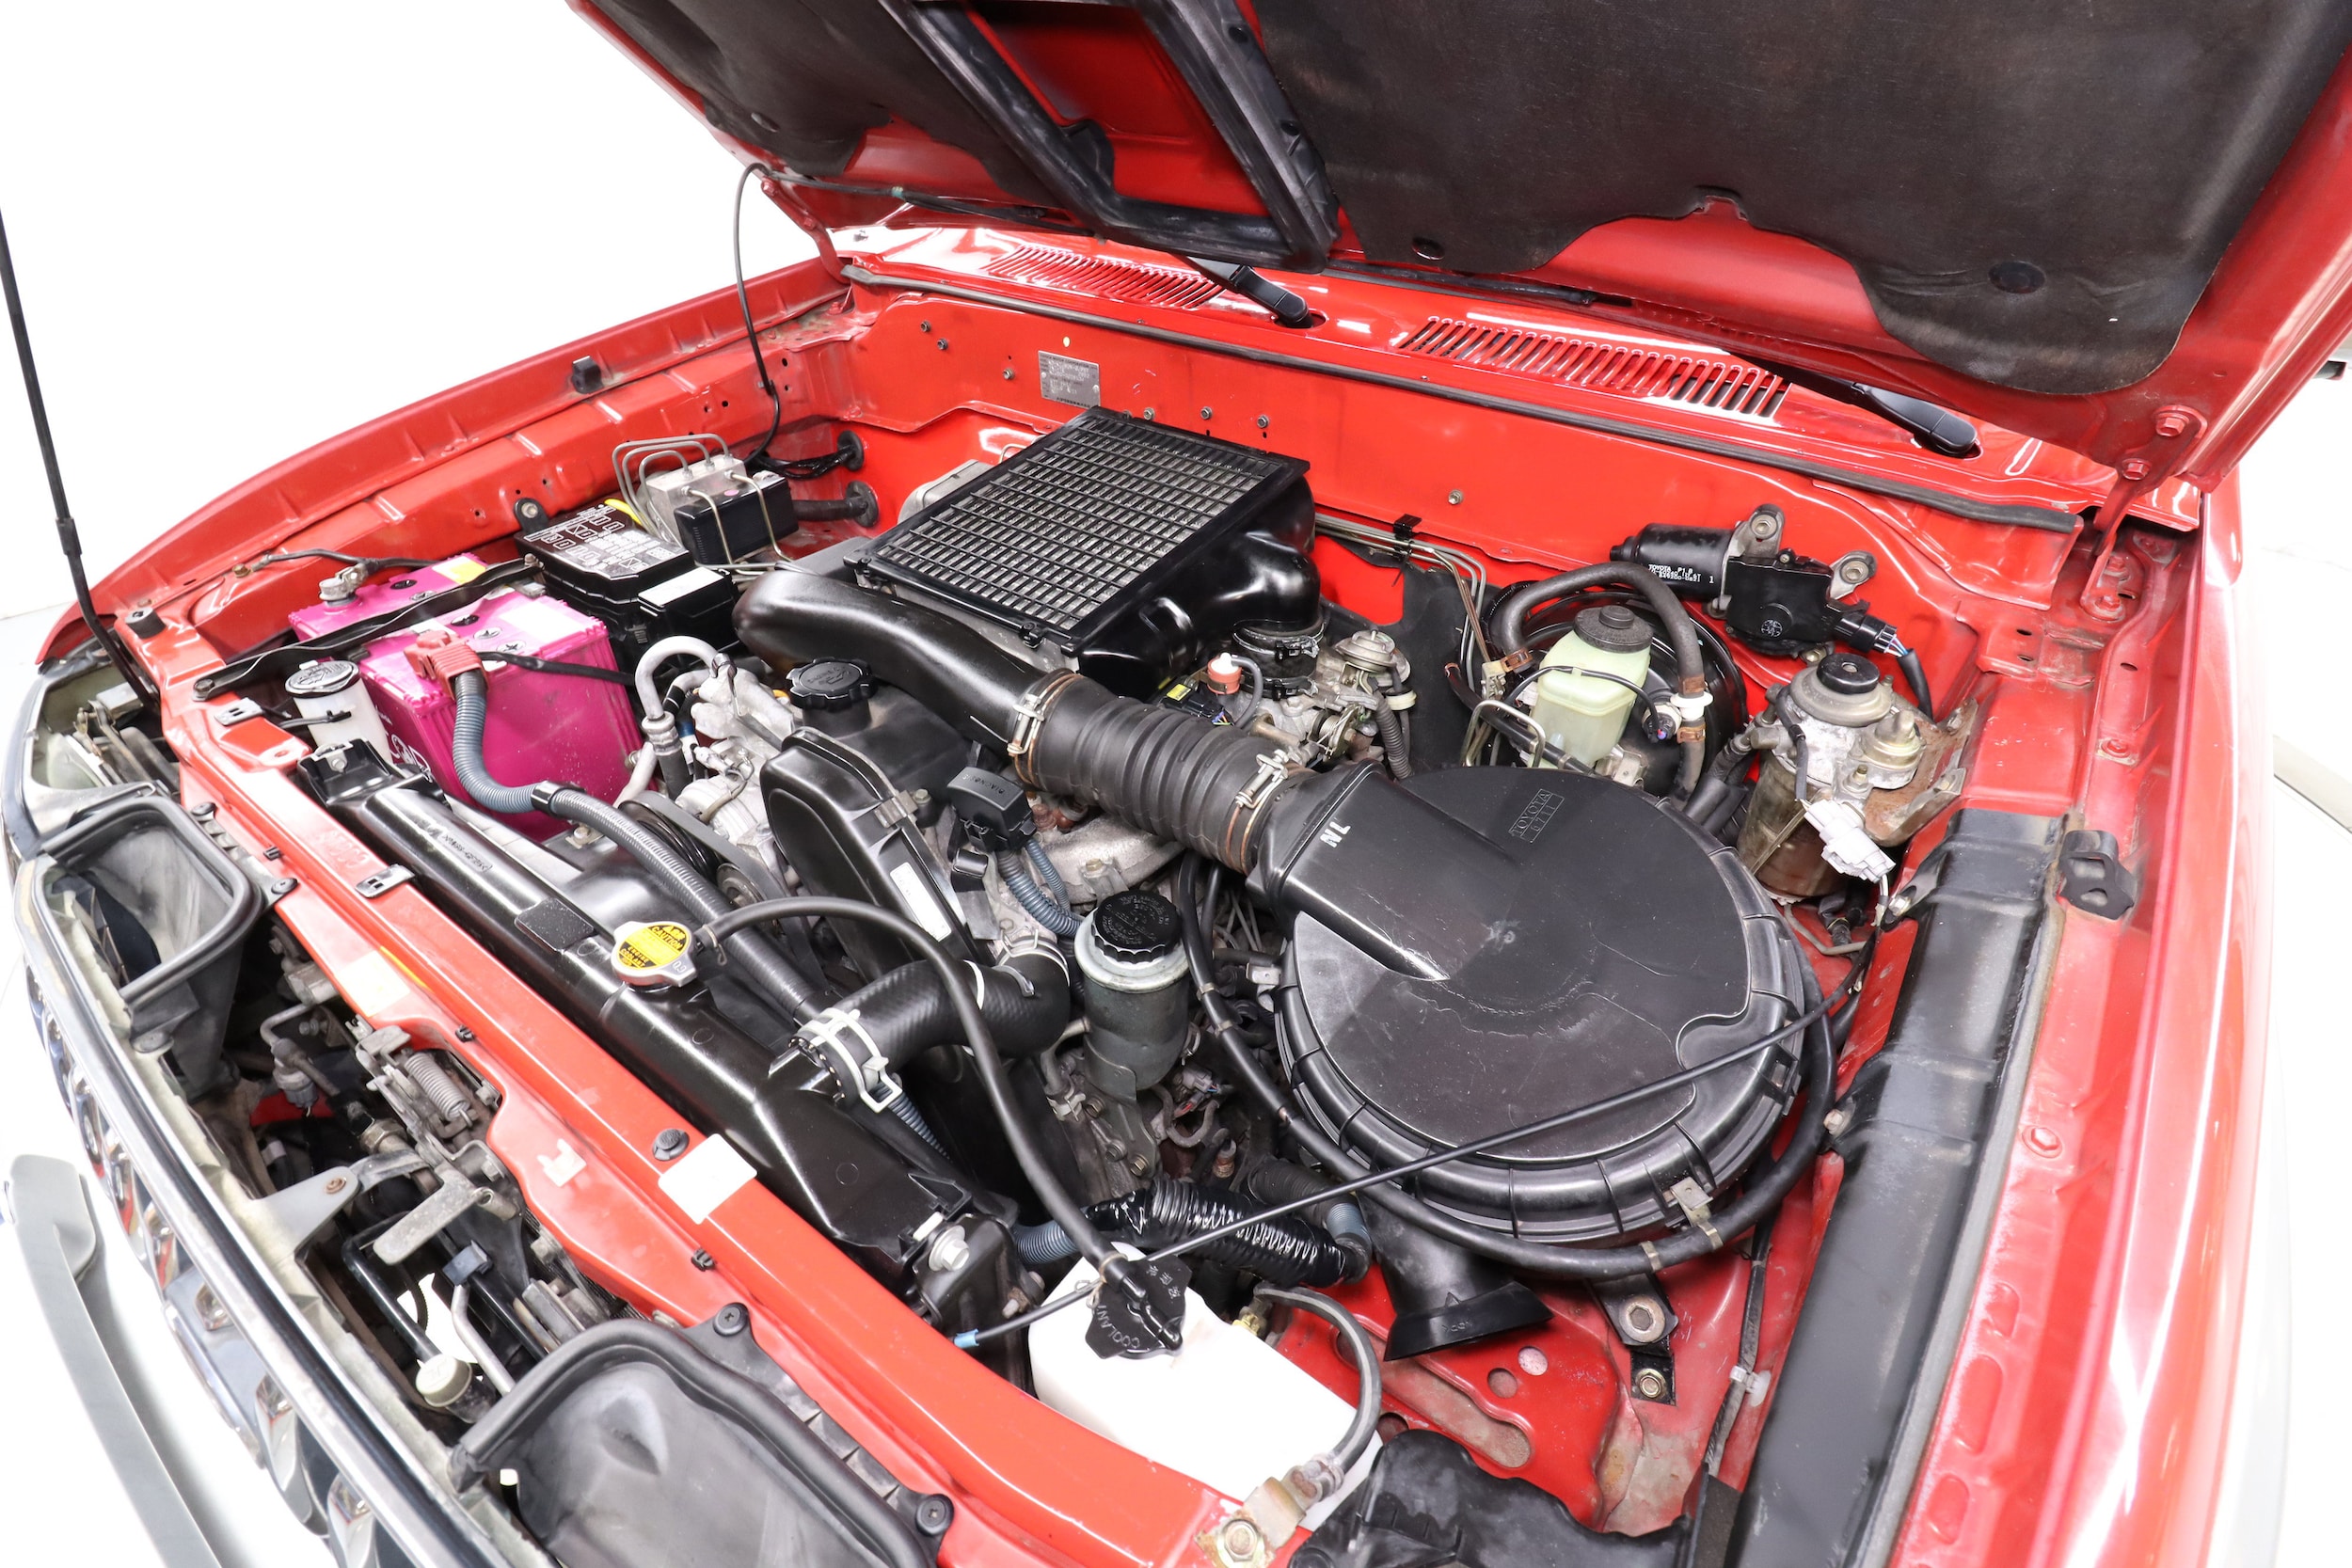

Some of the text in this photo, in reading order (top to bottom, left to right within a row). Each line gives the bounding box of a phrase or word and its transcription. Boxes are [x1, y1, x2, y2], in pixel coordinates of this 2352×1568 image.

[1512, 790, 1552, 836] TOYOTA
[651, 926, 683, 950] CAUTION
[621, 948, 646, 967] COOLANT
[628, 945, 649, 963] ENGINE
[1094, 1304, 1141, 1349] COOLANT
